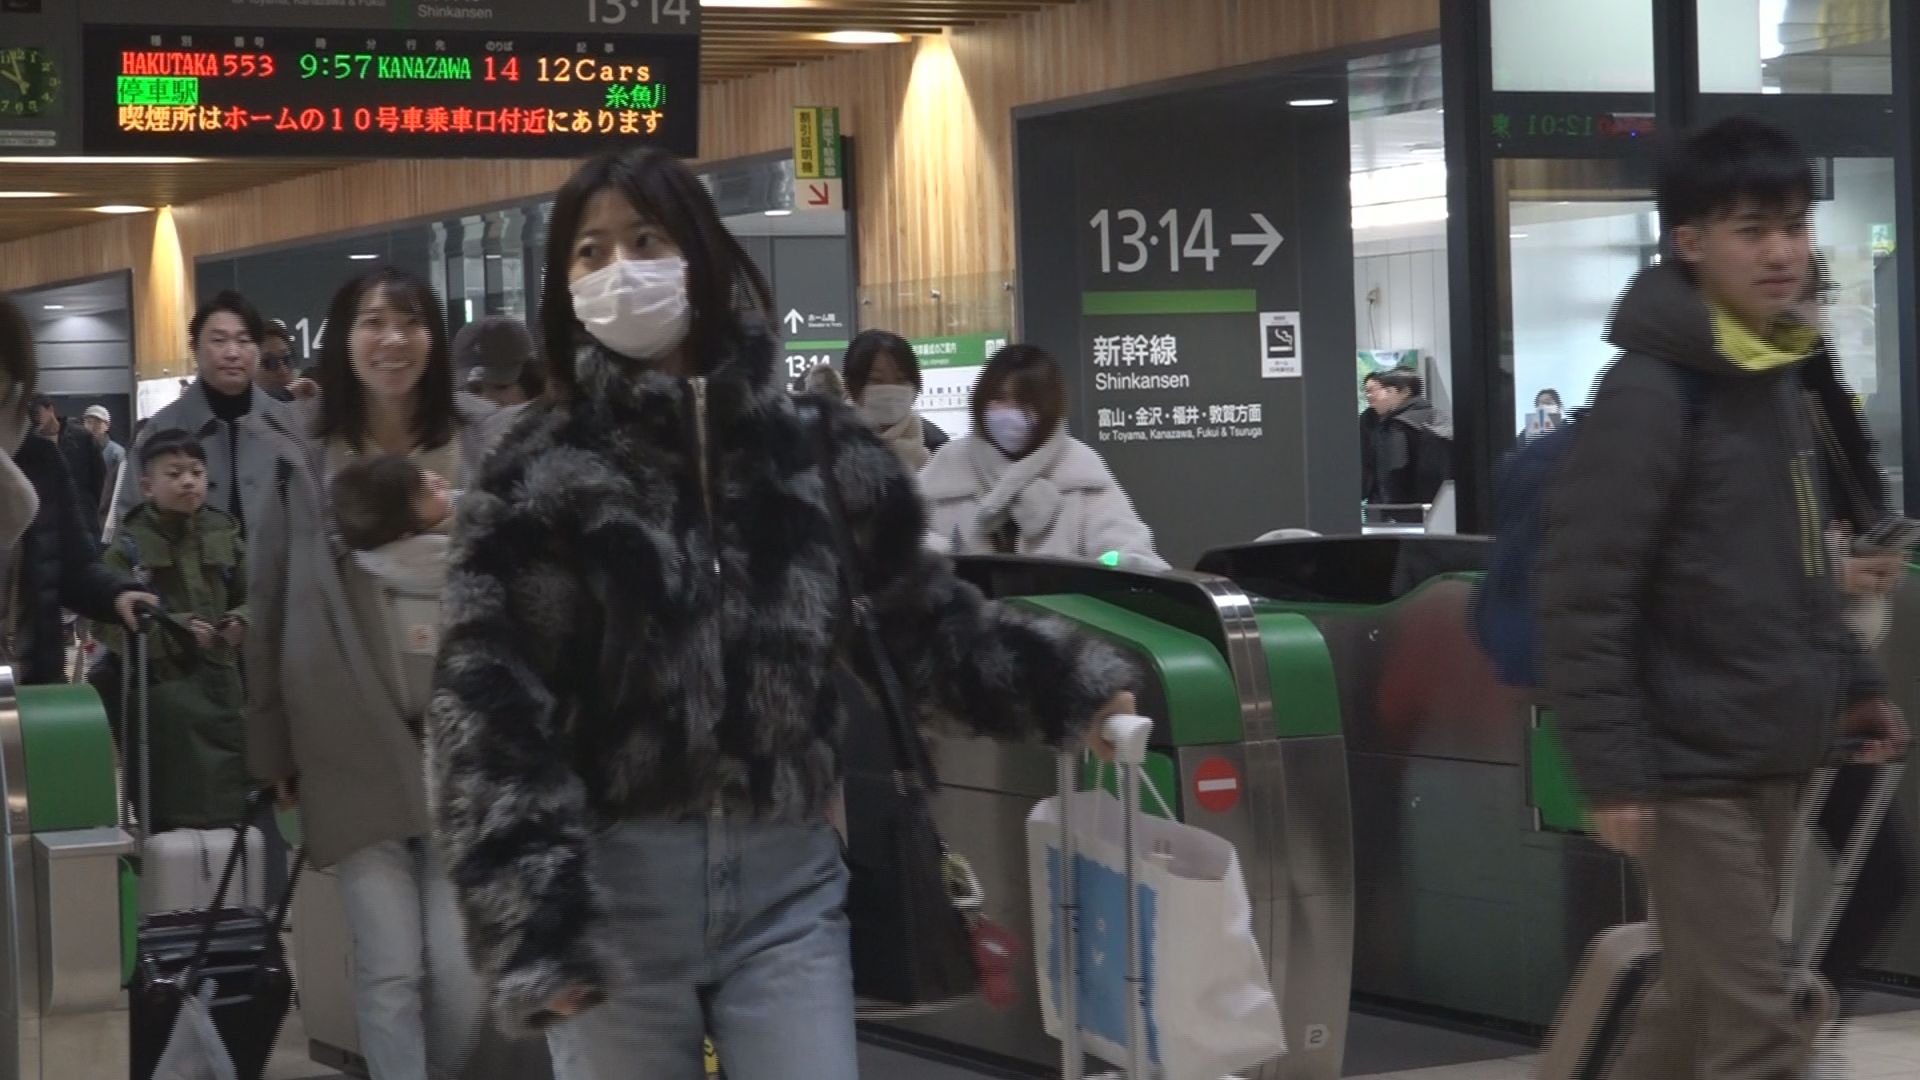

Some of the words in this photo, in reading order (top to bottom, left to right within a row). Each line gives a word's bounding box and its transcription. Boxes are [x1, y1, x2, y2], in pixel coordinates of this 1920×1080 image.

[417, 4, 493, 19] Shinkansen
[122, 52, 218, 76] HAKUTAKA
[223, 54, 274, 77] 553
[299, 54, 372, 79] 9:57
[378, 56, 471, 80] KANAZAWA
[483, 56, 519, 81] 14
[118, 77, 197, 104] 停車駅
[1089, 208, 1220, 273] 13·14
[1093, 334, 1178, 367] 新幹線
[1095, 372, 1190, 391] Shinkansen
[1098, 404, 1262, 427] 富山・金沢・福井・敦賀方面
[1099, 430, 1110, 441] for
[1112, 429, 1148, 442] Toyama,
[1150, 428, 1195, 440] Kanazawa,
[1197, 427, 1219, 438] Fukui
[1220, 426, 1228, 437] &
[1229, 425, 1263, 439] Tsuruga
[1311, 1029, 1322, 1044] 2
